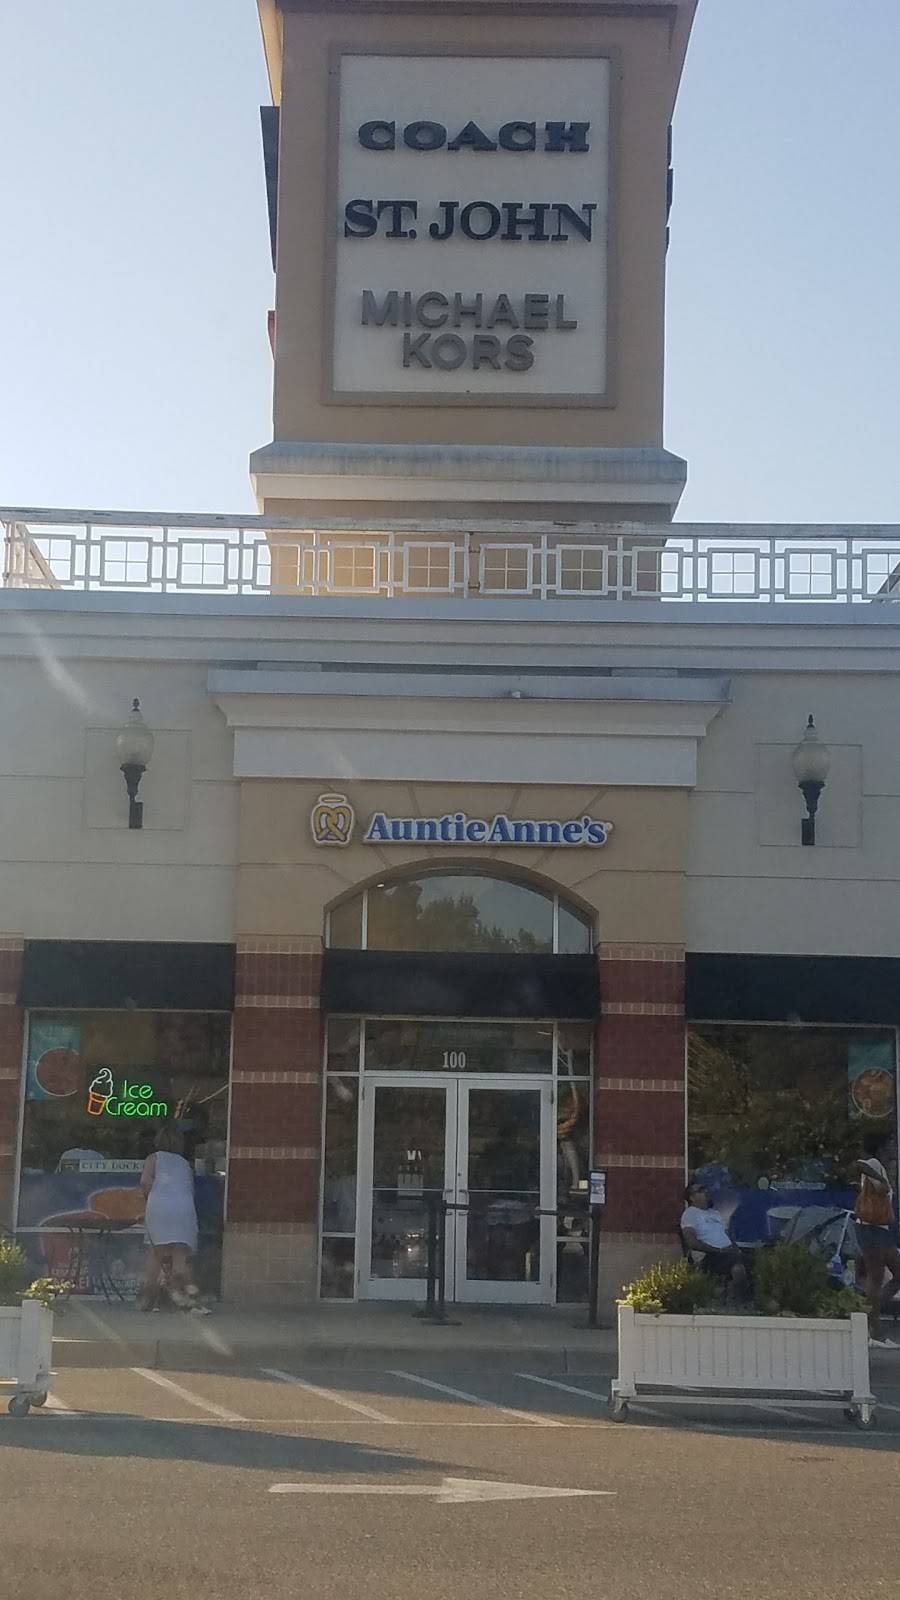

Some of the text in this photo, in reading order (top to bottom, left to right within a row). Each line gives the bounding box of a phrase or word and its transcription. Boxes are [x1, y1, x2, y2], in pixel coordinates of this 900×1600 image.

[358, 120, 590, 152] COACH
[344, 199, 597, 242] ST. JOHN
[360, 289, 578, 330] MICHAEL
[402, 332, 535, 371] KORS
[441, 1051, 466, 1069] 100
[123, 1080, 154, 1099] Ice
[105, 1097, 168, 1117] Cream
